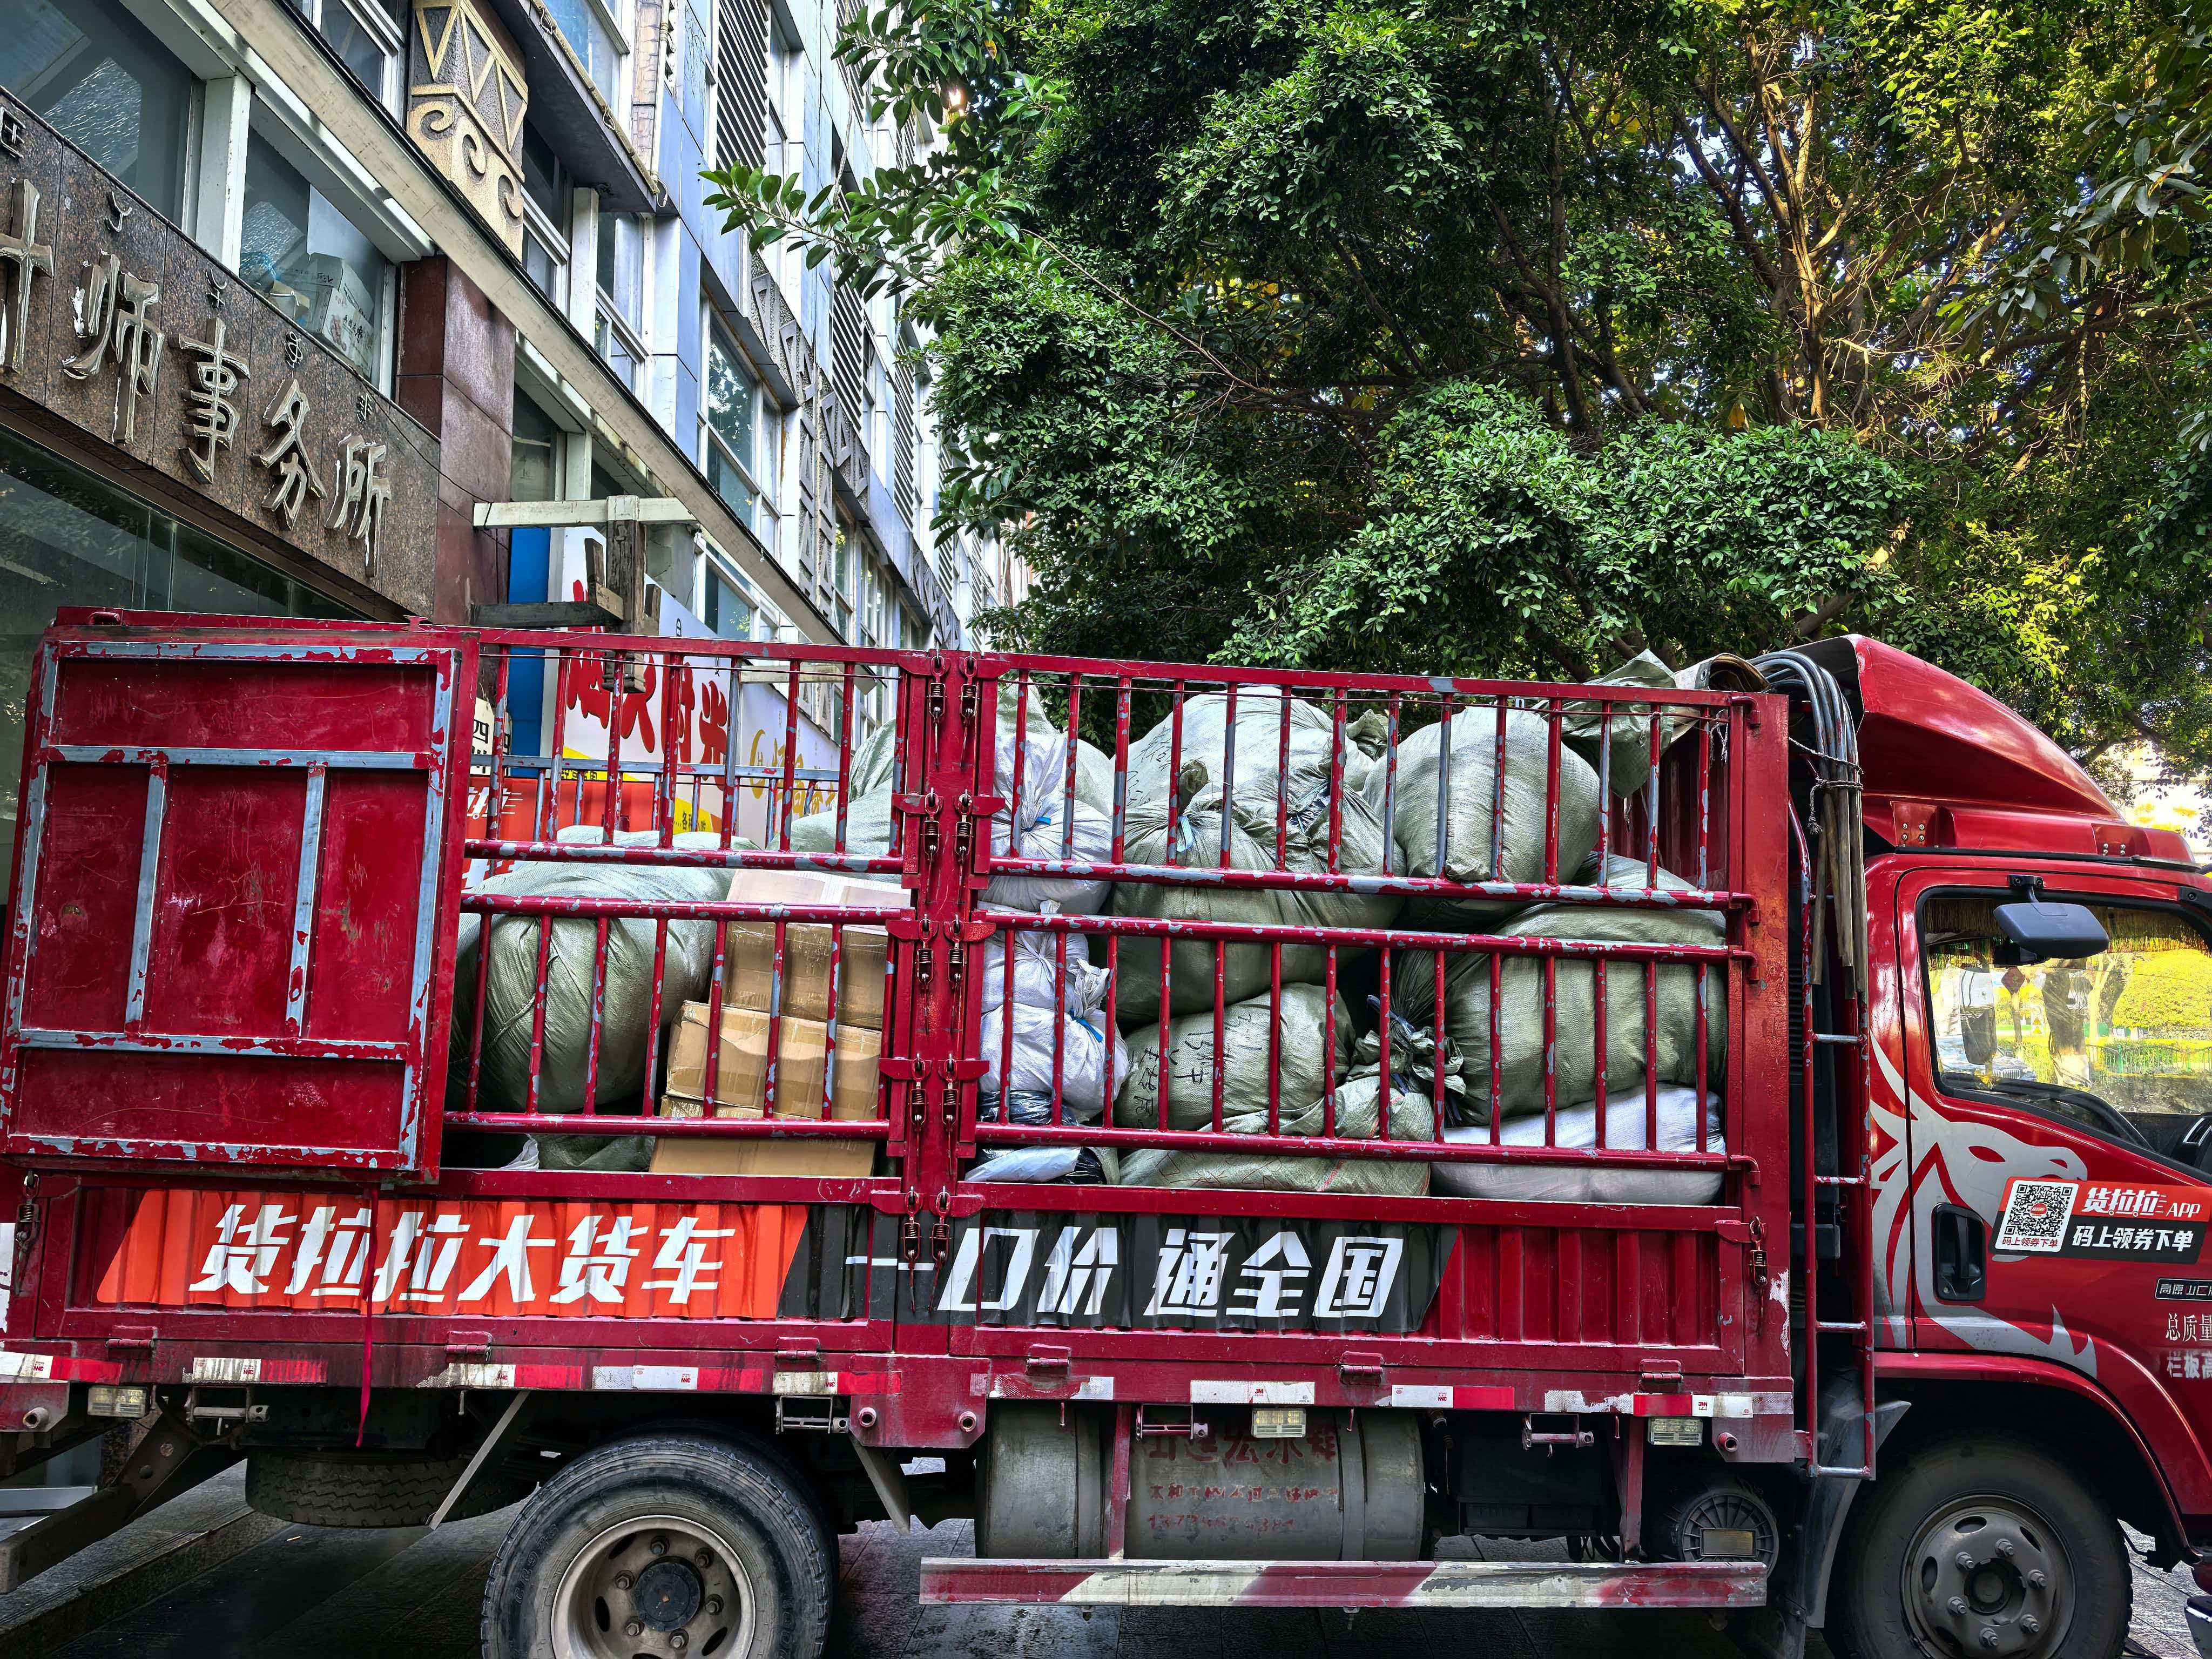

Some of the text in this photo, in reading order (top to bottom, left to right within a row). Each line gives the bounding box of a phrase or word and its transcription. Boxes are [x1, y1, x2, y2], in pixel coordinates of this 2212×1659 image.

[2082, 1187, 2201, 1218] 货拉拉 APP
[189, 1203, 735, 1305] 货拉拉大货车
[2002, 1236, 2058, 1248] 码上领券下单
[2072, 1225, 2194, 1252] 码上领券下单
[845, 1226, 1404, 1318] 一口价 通全国
